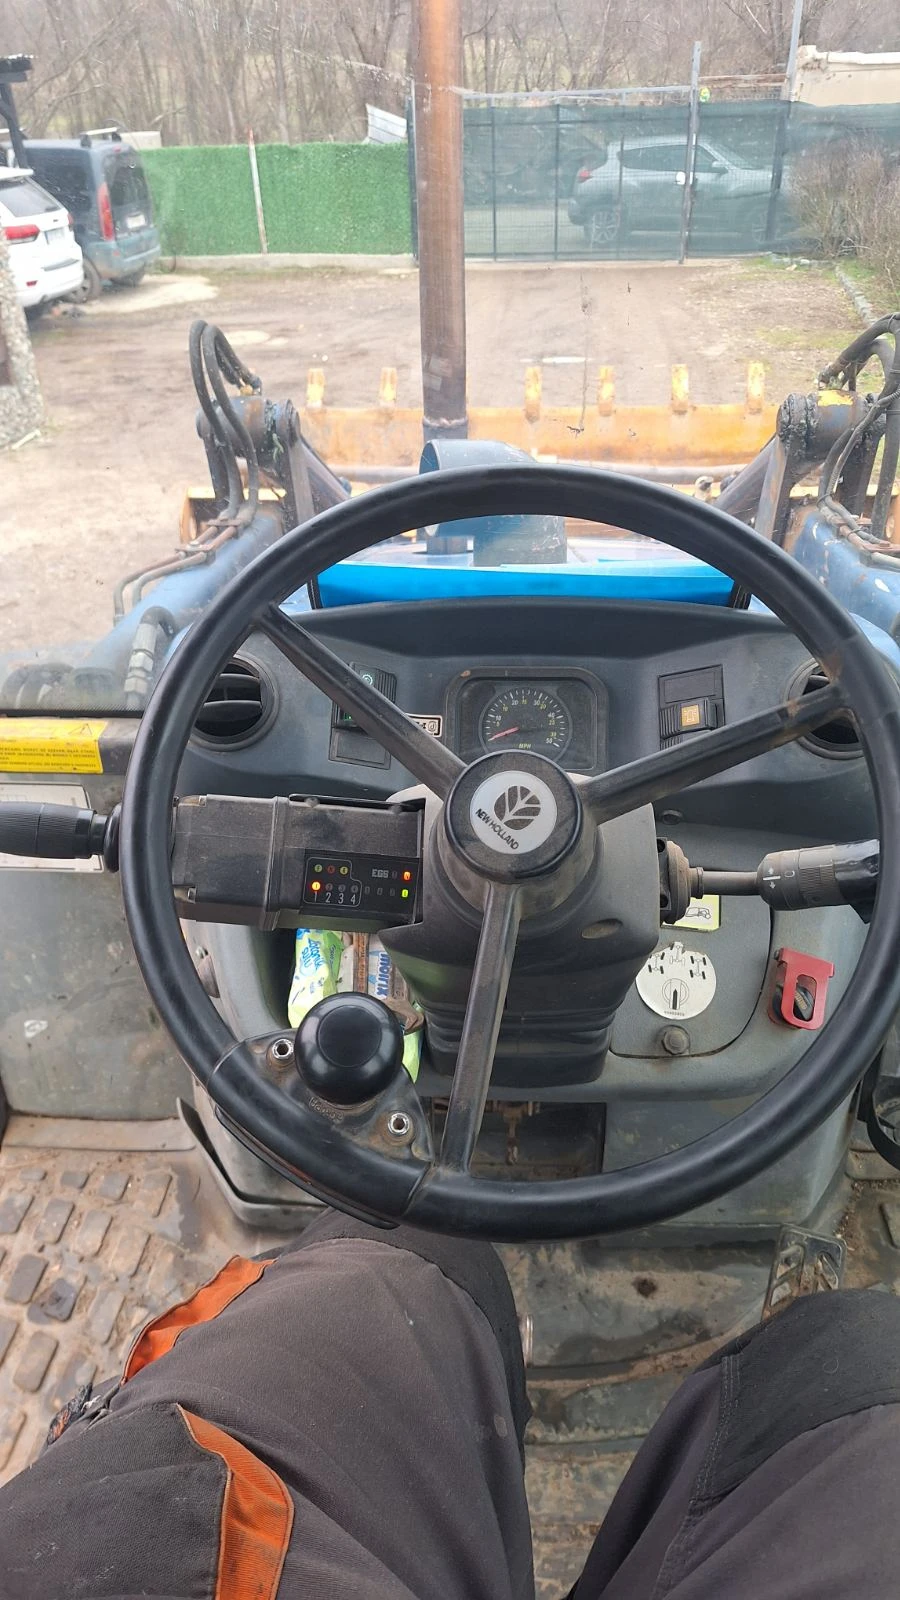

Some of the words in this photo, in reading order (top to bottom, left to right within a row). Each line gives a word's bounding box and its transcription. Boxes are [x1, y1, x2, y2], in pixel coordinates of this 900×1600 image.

[475, 808, 489, 824] NEW
[489, 822, 519, 850] HOLLAND
[371, 868, 389, 878] EGS
[325, 892, 332, 903] 2
[338, 893, 344, 904] 3
[350, 894, 356, 905] 4
